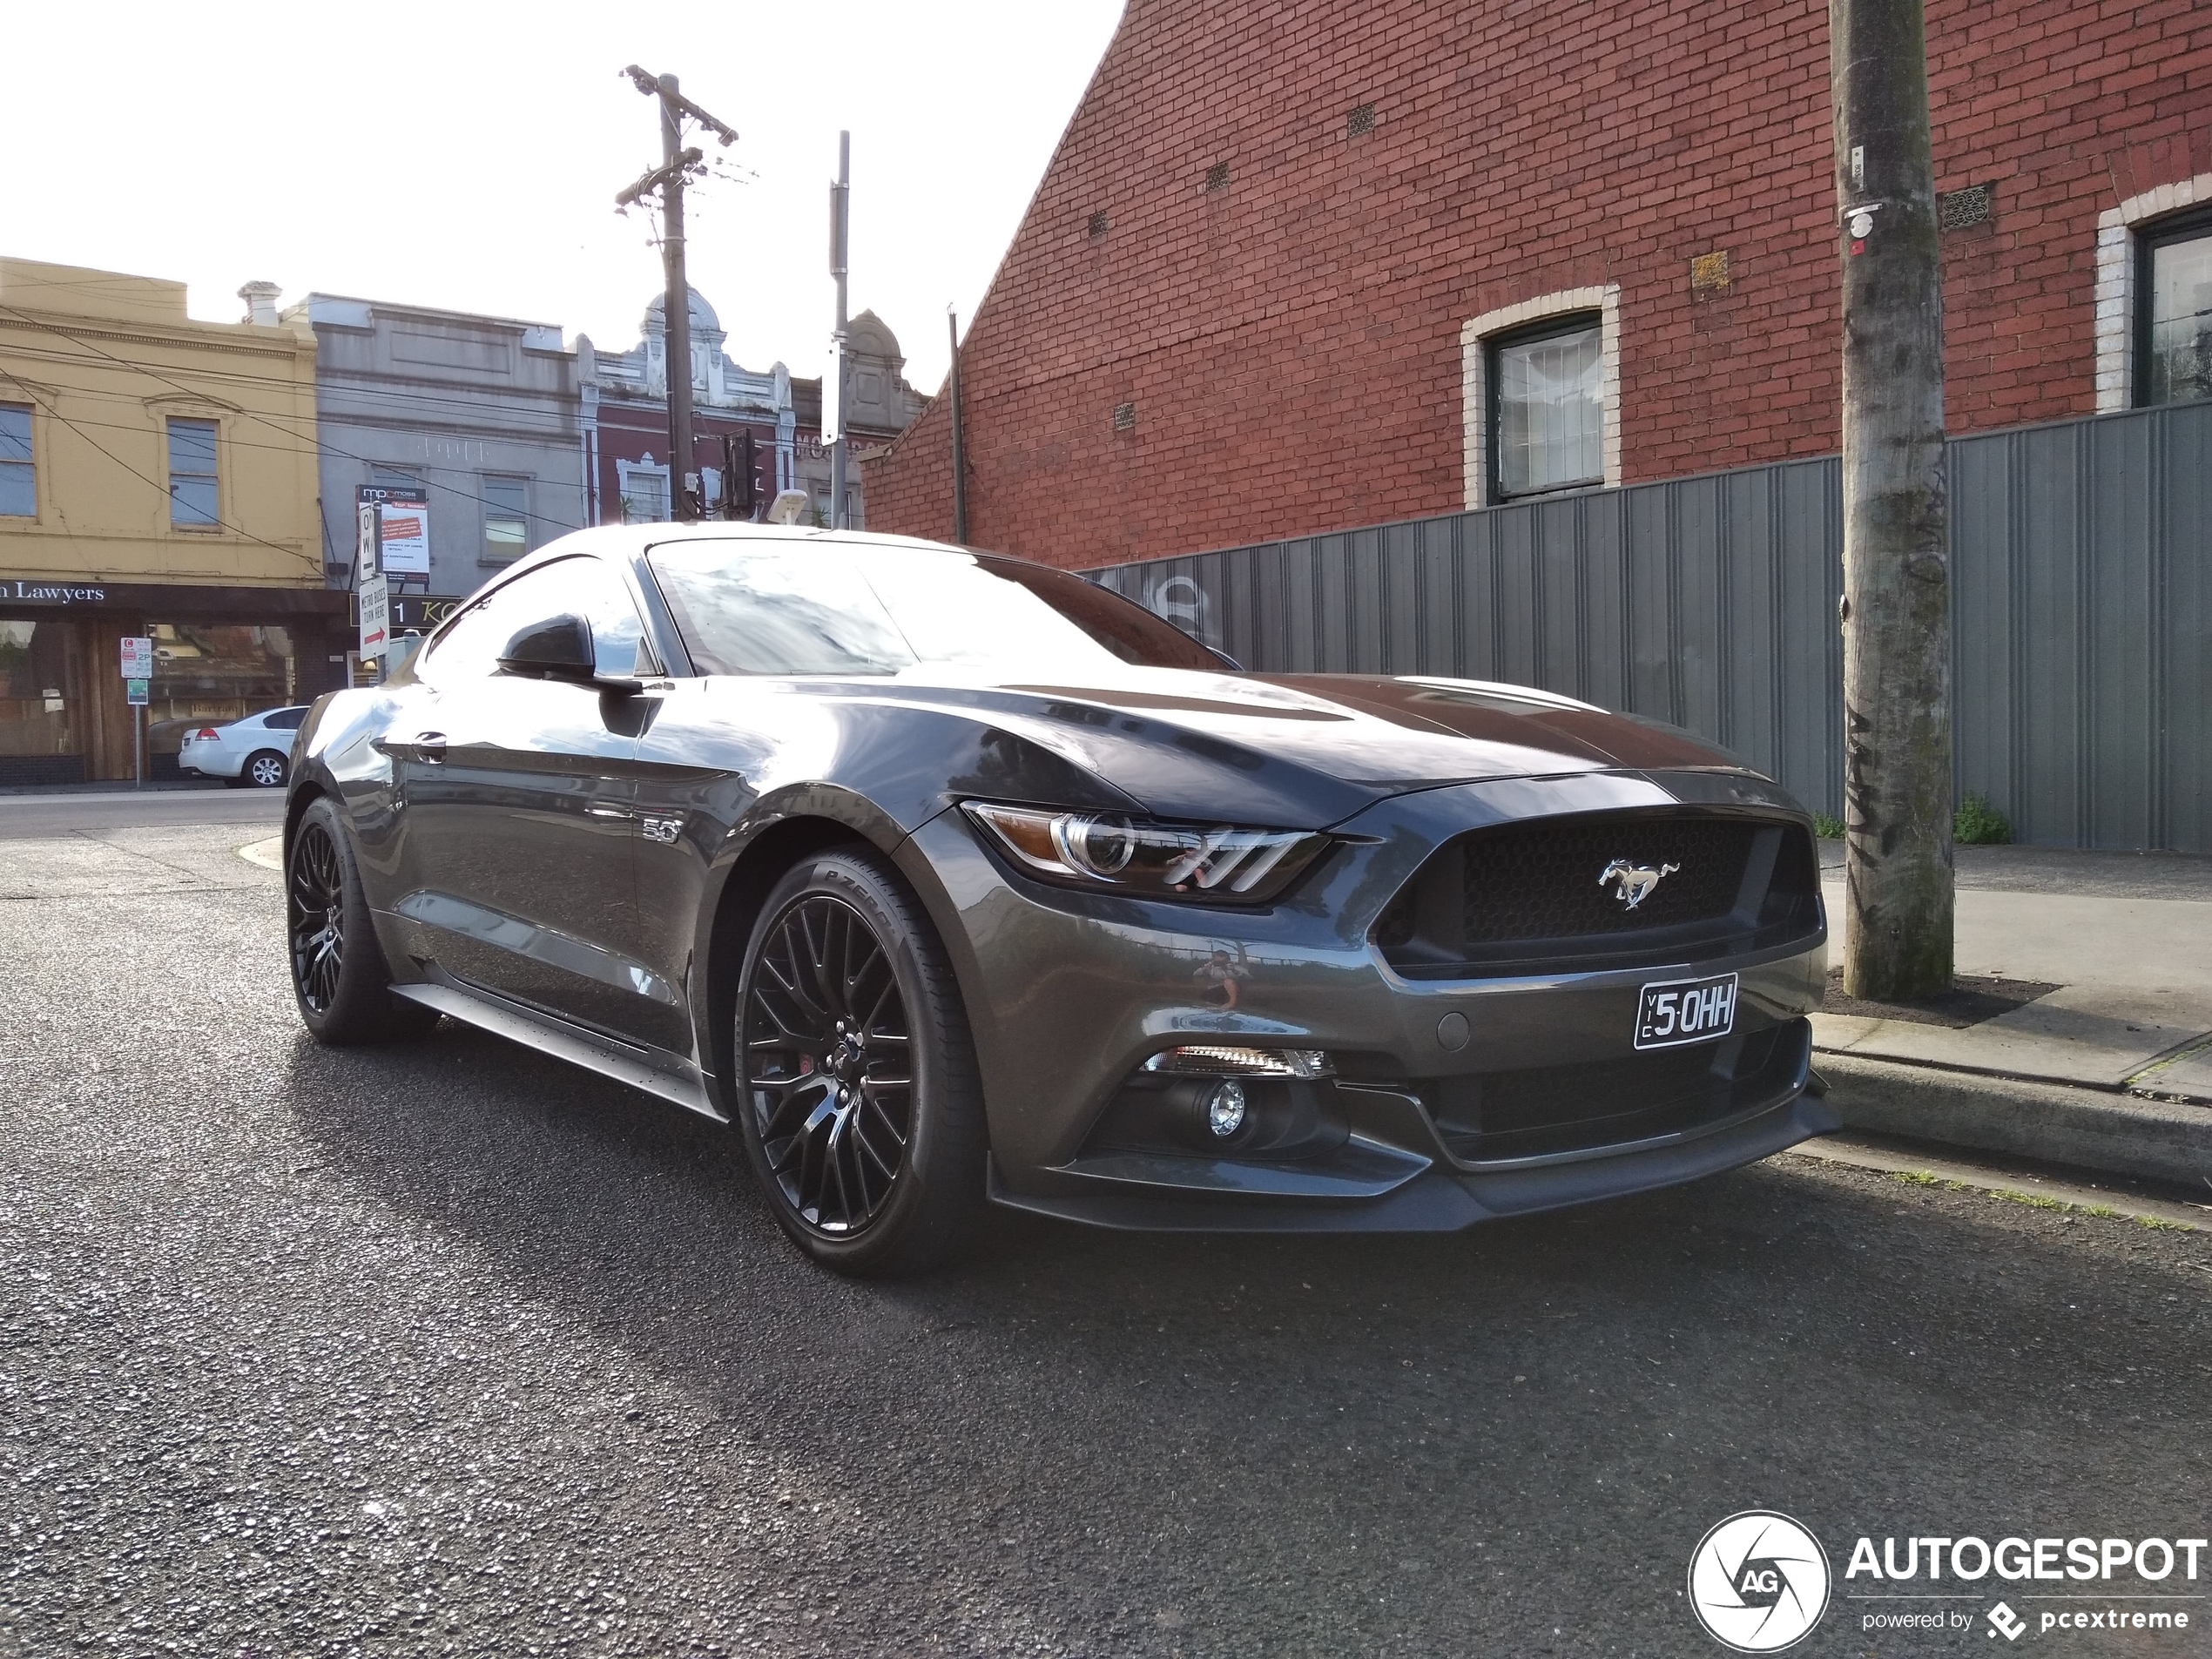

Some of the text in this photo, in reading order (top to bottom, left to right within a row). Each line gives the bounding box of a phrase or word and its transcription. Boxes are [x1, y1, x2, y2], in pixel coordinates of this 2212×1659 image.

[15, 582, 105, 604] Lawyers
[374, 587, 386, 604] BUSES
[374, 604, 385, 619] HERE
[395, 603, 404, 623] 1
